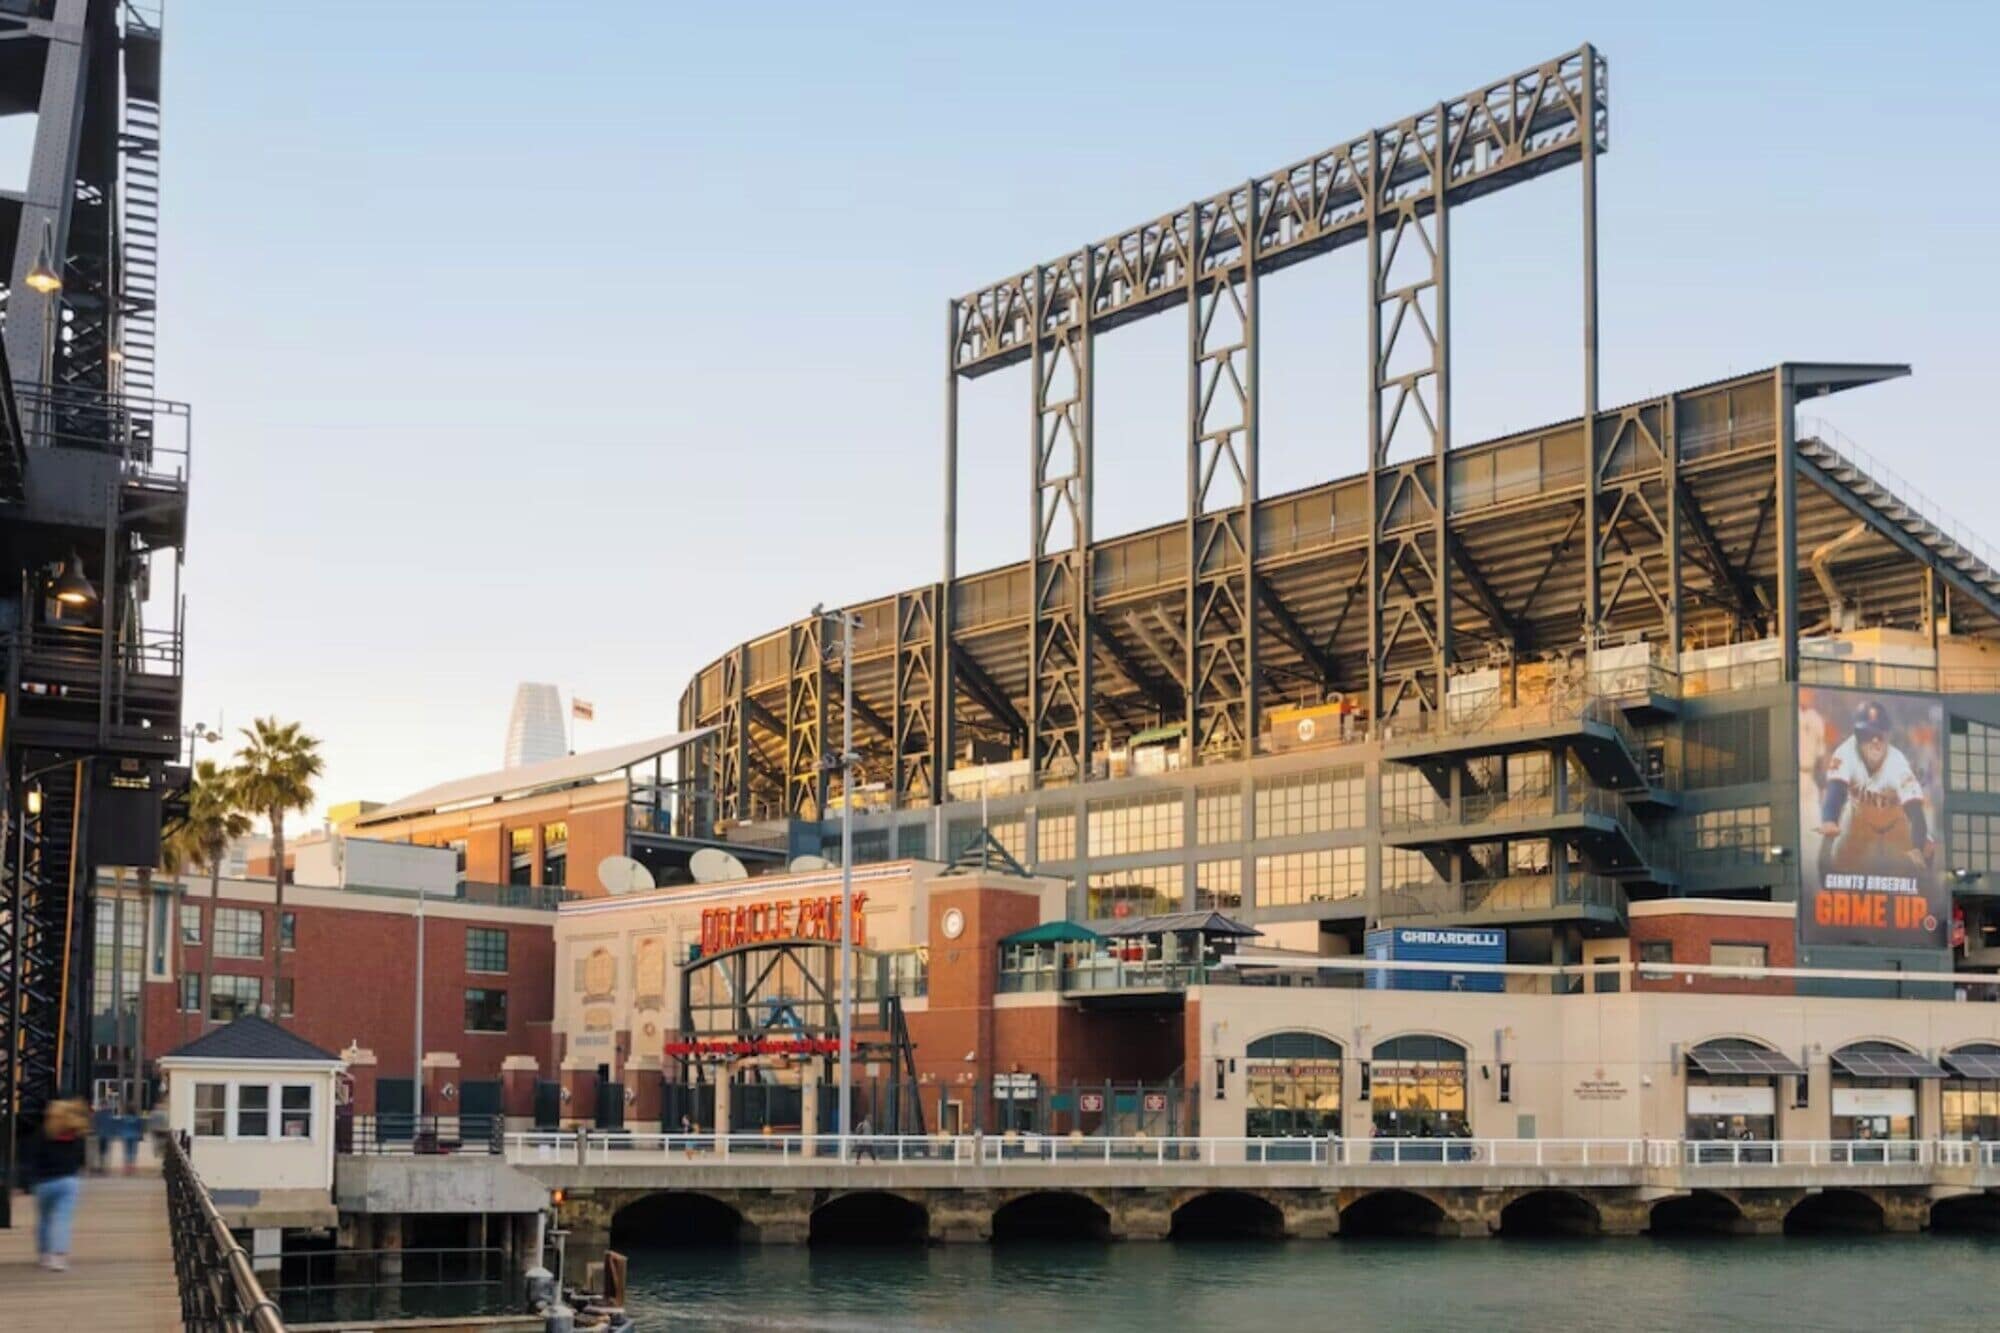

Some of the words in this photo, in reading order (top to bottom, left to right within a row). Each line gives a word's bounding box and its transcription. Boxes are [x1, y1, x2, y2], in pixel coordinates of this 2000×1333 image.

[1826, 874, 1864, 890] GIANTS
[1867, 875, 1918, 894] BASEBALL
[1815, 891, 1887, 928] GAME
[702, 901, 792, 957] ORACLE
[1401, 931, 1498, 946] GHIRARDELLI
